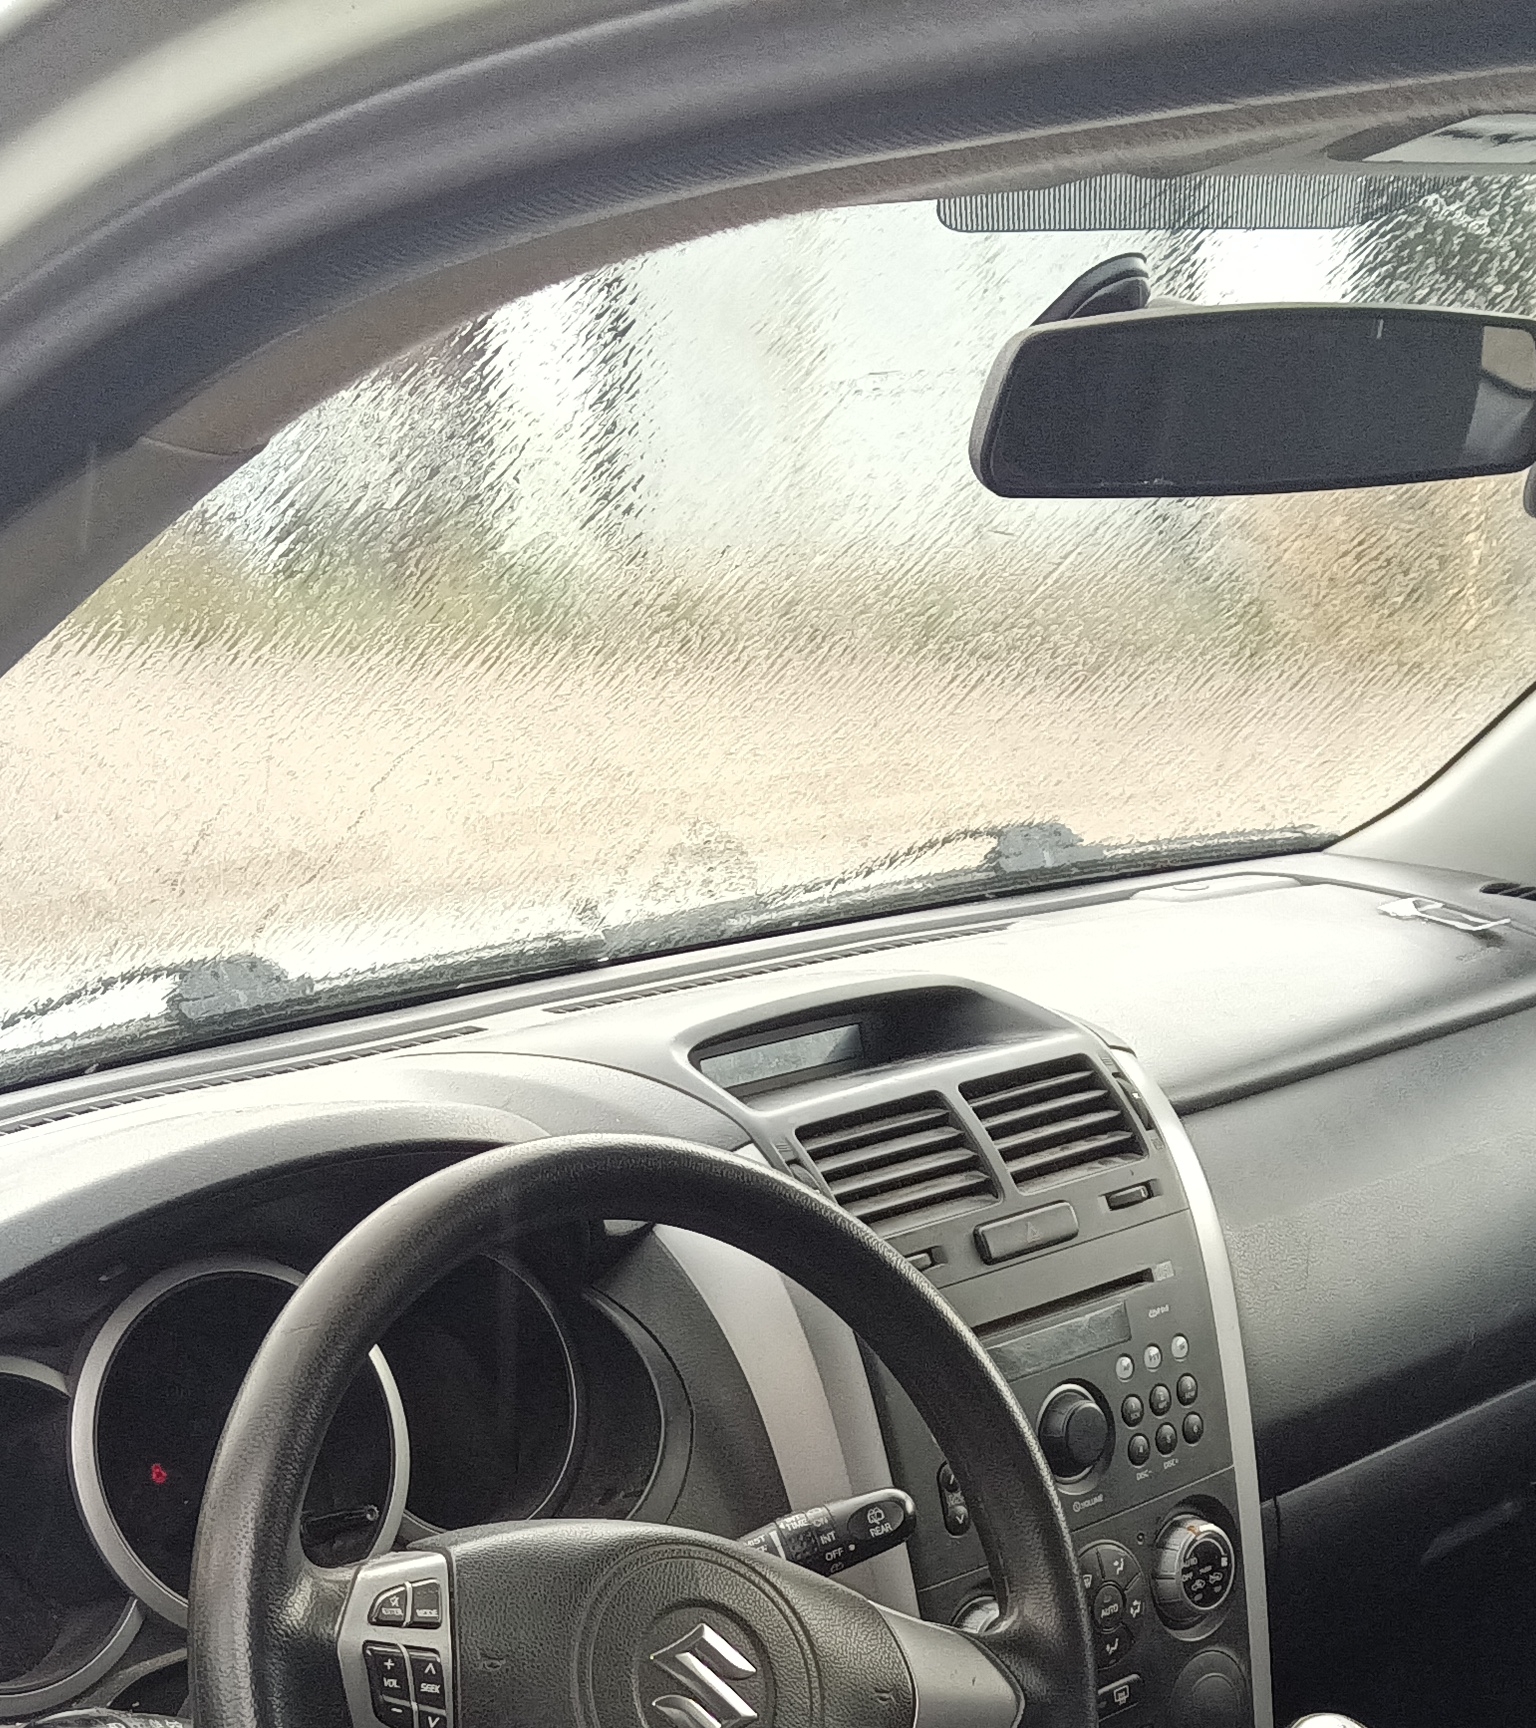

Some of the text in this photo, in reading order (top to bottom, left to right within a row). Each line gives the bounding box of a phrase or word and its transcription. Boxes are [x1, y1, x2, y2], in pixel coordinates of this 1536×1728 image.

[785, 1519, 809, 1532] TIME
[870, 1522, 894, 1538] REAR
[820, 1530, 837, 1545] INT
[825, 1547, 845, 1562] OFF
[1101, 1603, 1119, 1617] AUTO
[420, 1682, 440, 1694] SEEK
